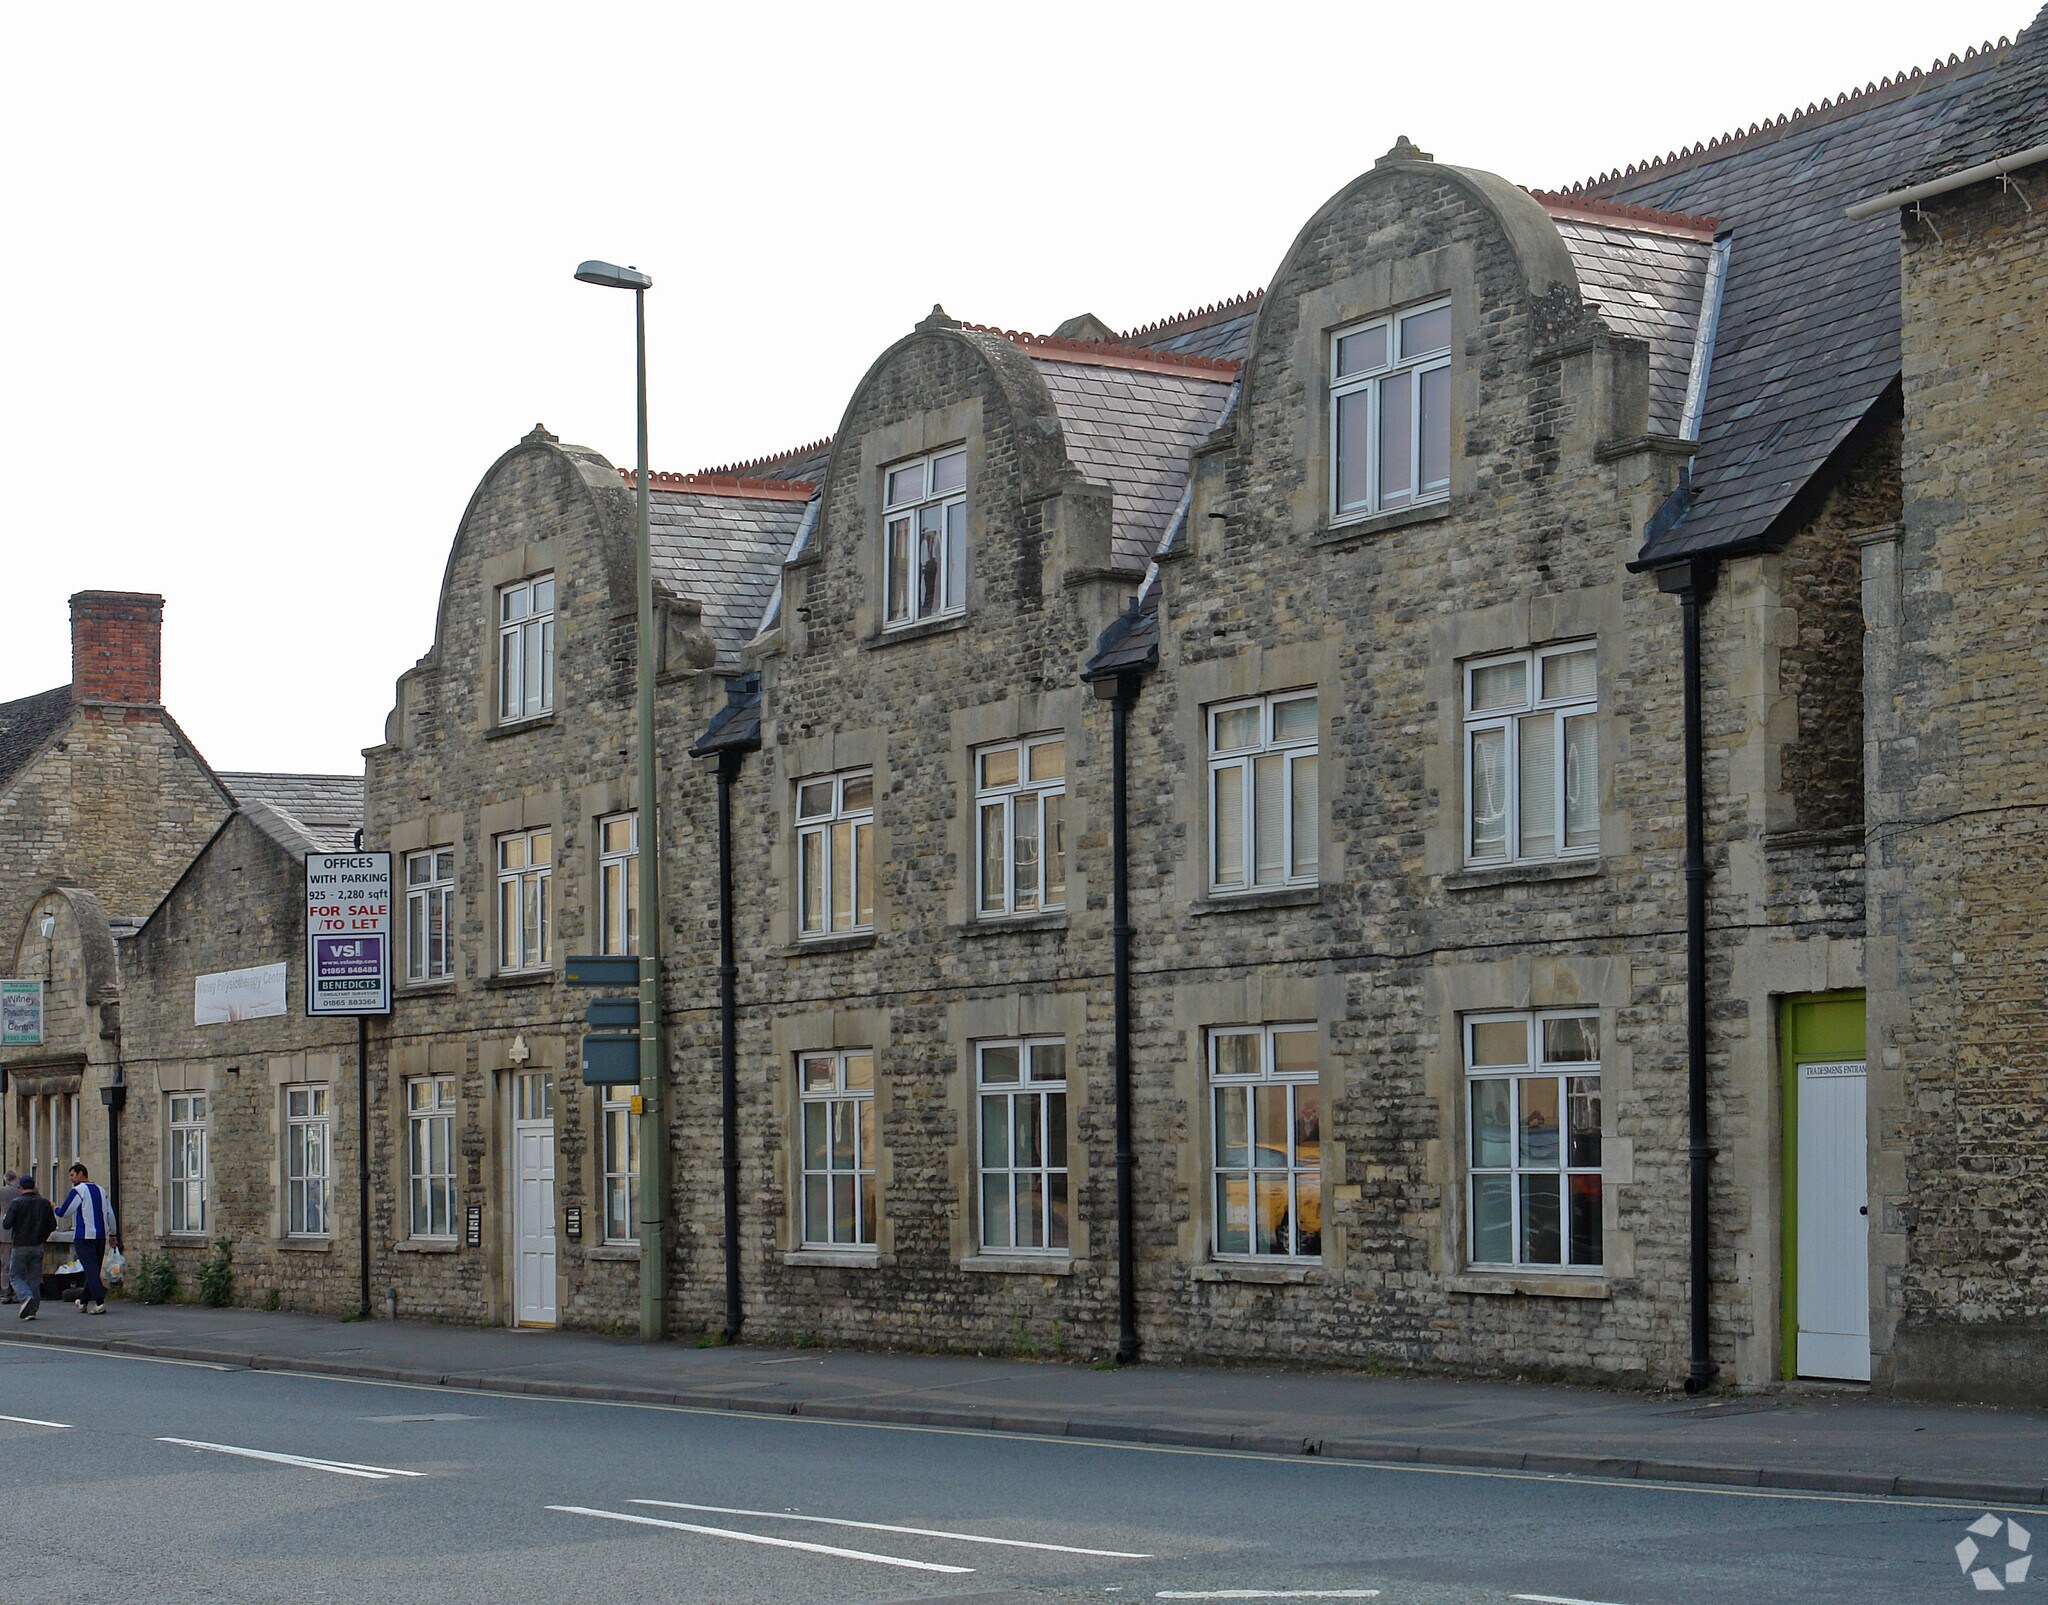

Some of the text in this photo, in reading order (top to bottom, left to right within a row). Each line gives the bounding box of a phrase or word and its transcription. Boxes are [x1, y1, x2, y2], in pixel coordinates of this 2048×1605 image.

[324, 857, 373, 869] OFFICES
[310, 873, 388, 884] WITH PARKING
[309, 891, 326, 900] 925
[338, 890, 364, 900] 2,280
[368, 889, 388, 900] sqft
[309, 905, 387, 916] FOR SALE
[319, 919, 378, 930] /TO LET
[321, 967, 346, 975] 01865
[322, 980, 376, 990] BENEDICTS
[7, 995, 35, 1005] Witney
[323, 999, 346, 1007] 01865
[3, 1007, 39, 1018] Physiotherapy
[8, 1022, 34, 1031] Centre
